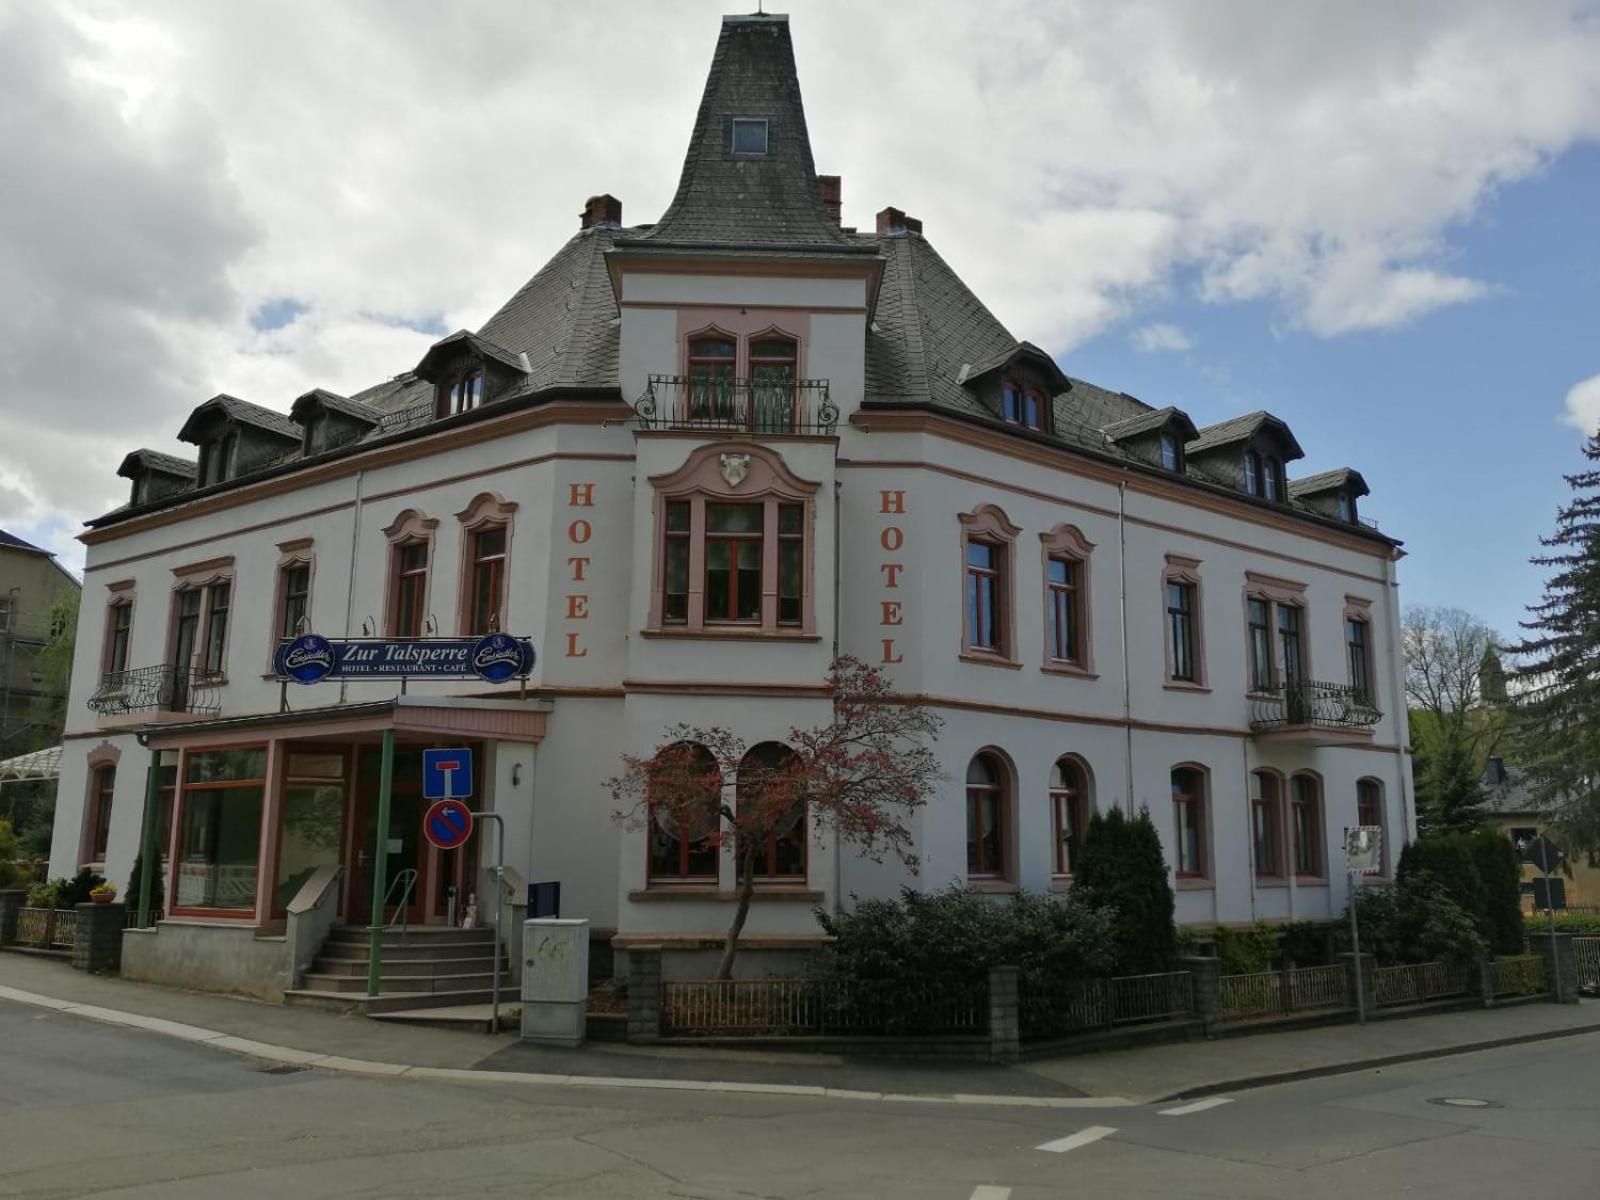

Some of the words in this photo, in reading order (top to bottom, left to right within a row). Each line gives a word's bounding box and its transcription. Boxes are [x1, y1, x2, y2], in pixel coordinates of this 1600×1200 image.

[565, 483, 595, 657] HOTEL
[879, 490, 906, 663] HOTEL
[342, 644, 378, 660] Zur
[384, 644, 467, 664] Talsperre
[342, 664, 371, 672] HOTEL
[379, 664, 436, 672] RESTAURANT
